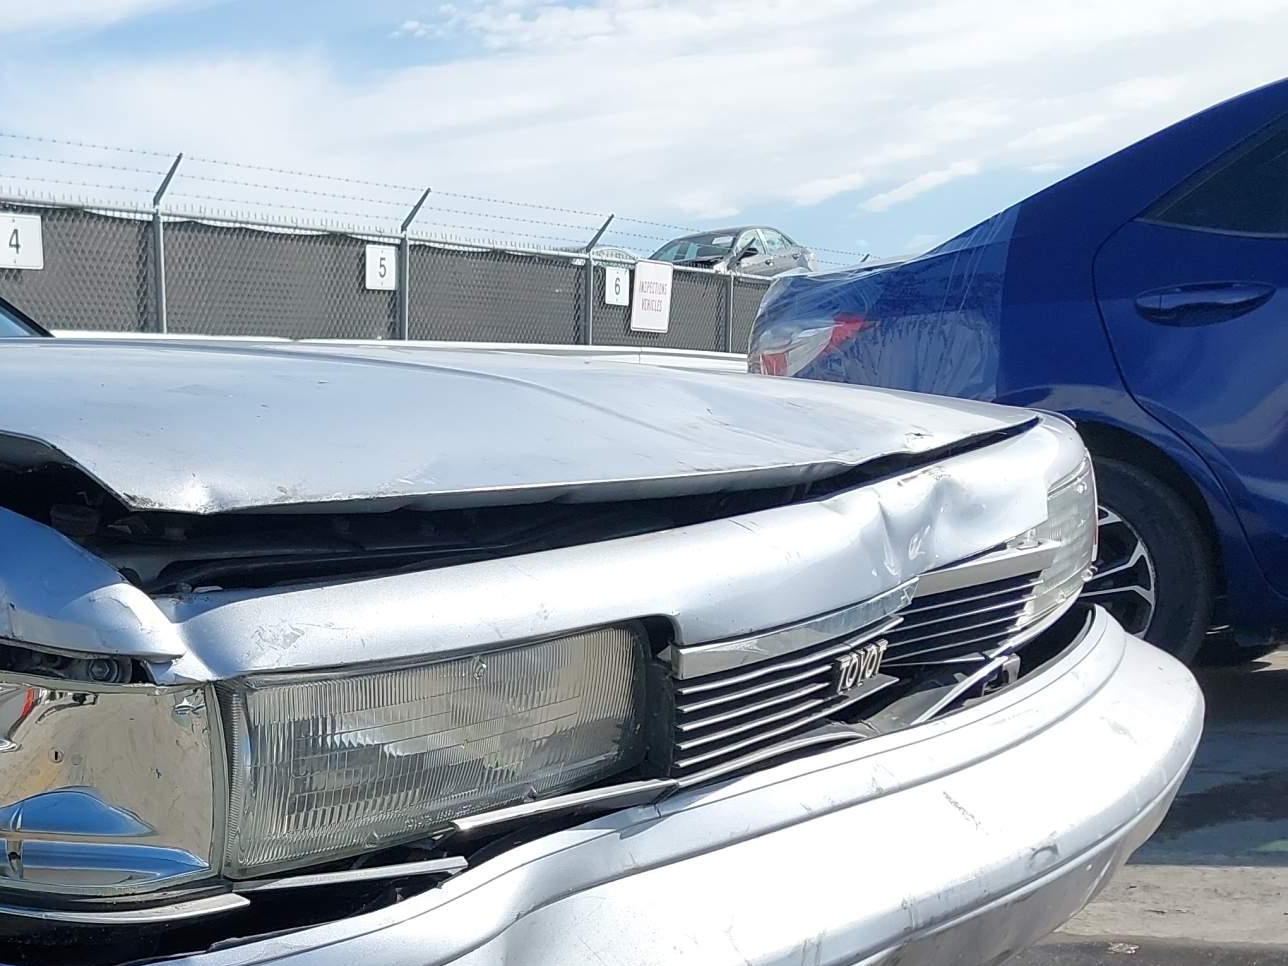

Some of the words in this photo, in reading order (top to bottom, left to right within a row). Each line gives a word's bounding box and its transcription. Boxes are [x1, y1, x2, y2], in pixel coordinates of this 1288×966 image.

[8, 229, 22, 255] 4
[378, 257, 387, 279] 5
[614, 277, 621, 296] 6
